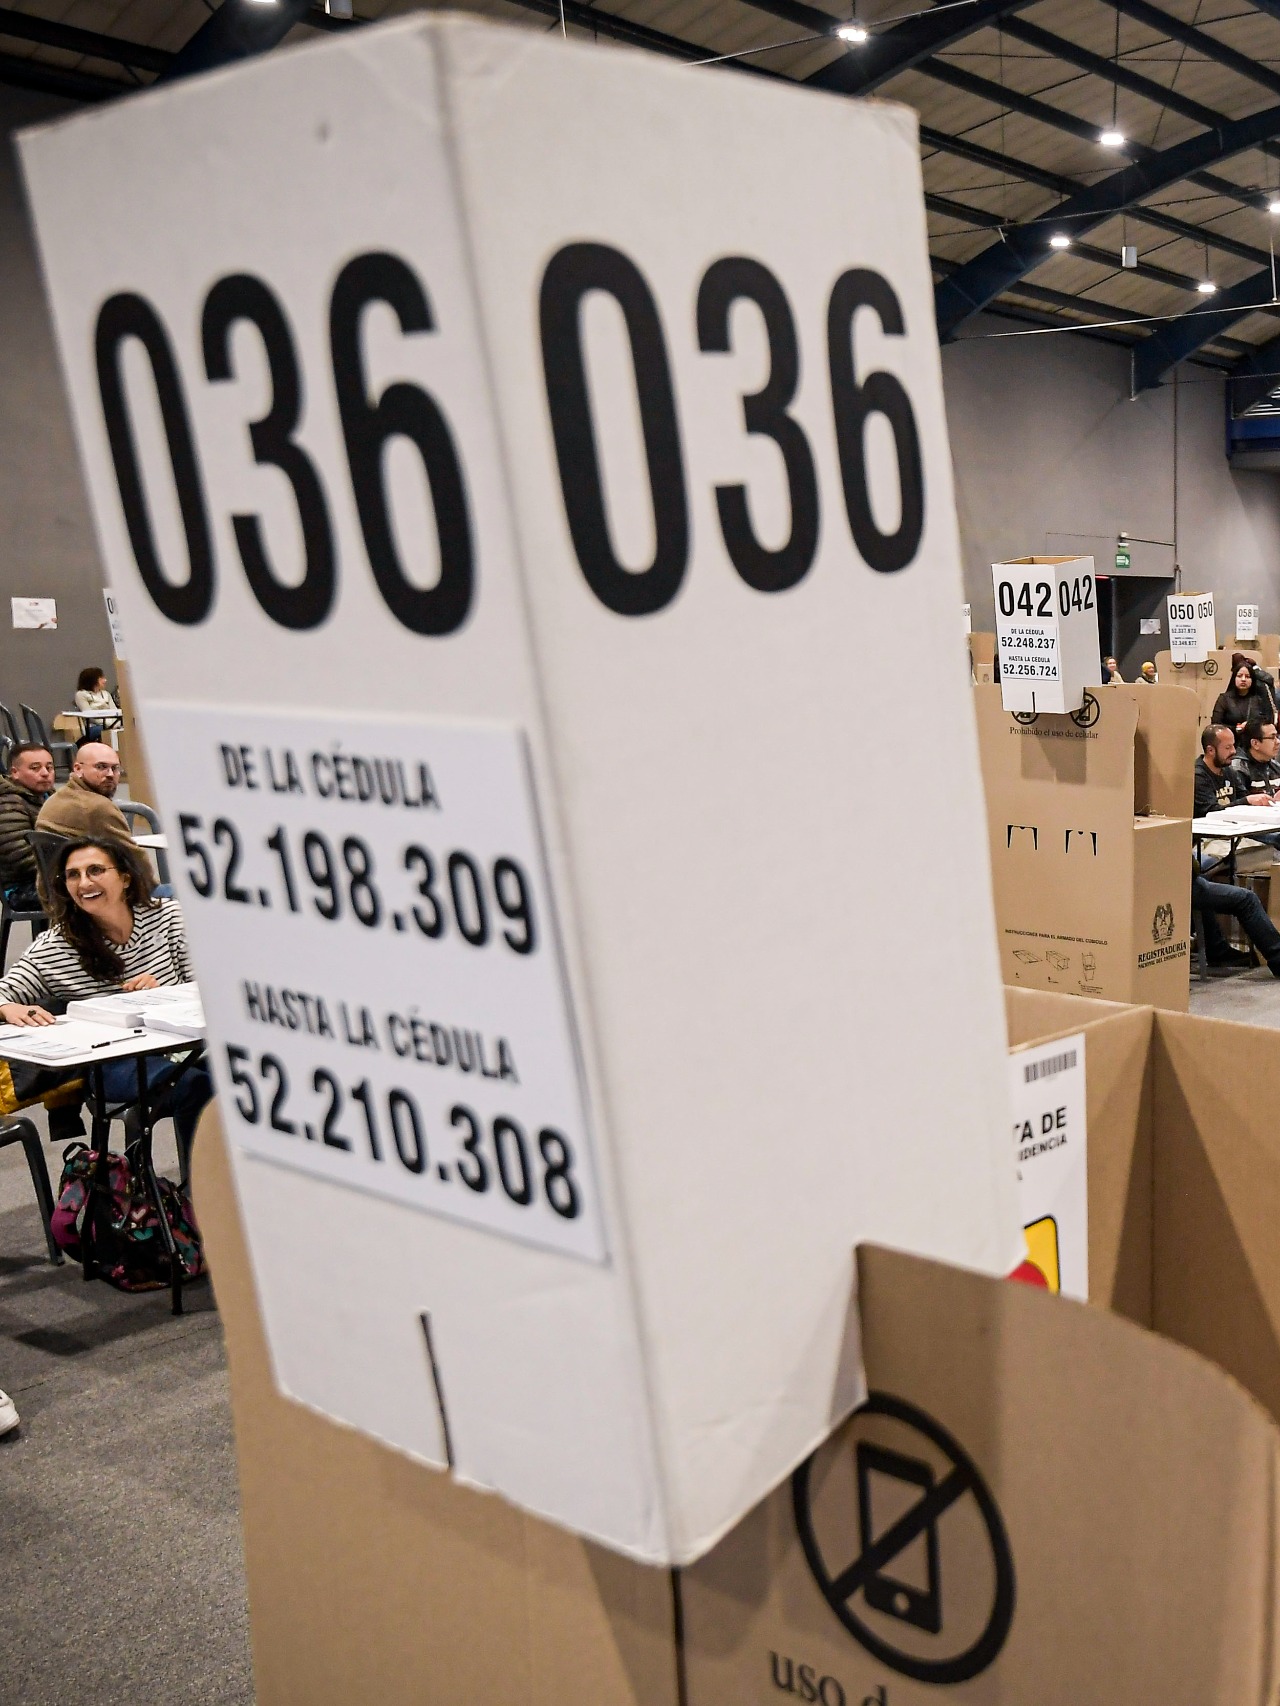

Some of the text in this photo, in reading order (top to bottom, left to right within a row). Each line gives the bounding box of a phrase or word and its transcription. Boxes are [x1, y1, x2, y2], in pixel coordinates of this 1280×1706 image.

[95, 251, 476, 638] 036
[538, 241, 925, 617] 036
[998, 581, 1053, 617] 042
[1058, 574, 1094, 617] 042
[1170, 604, 1194, 620] 050
[1198, 601, 1213, 619] 050
[1238, 609, 1252, 617] 058
[1001, 636, 1055, 649] 52.248.237
[1003, 663, 1057, 676] 52.256.724
[1009, 726, 1043, 736] Prohibido
[1043, 728, 1050, 736] el
[220, 741, 441, 810] DE LA CÉDULA
[177, 812, 539, 955] 52.198.309
[243, 980, 520, 1085] HASTA LA CÉDULA
[225, 1042, 581, 1220] 52.210.308
[1041, 1105, 1067, 1134] DE
[1018, 1133, 1067, 1161] IDENCIA
[770, 1650, 846, 1706] uso
